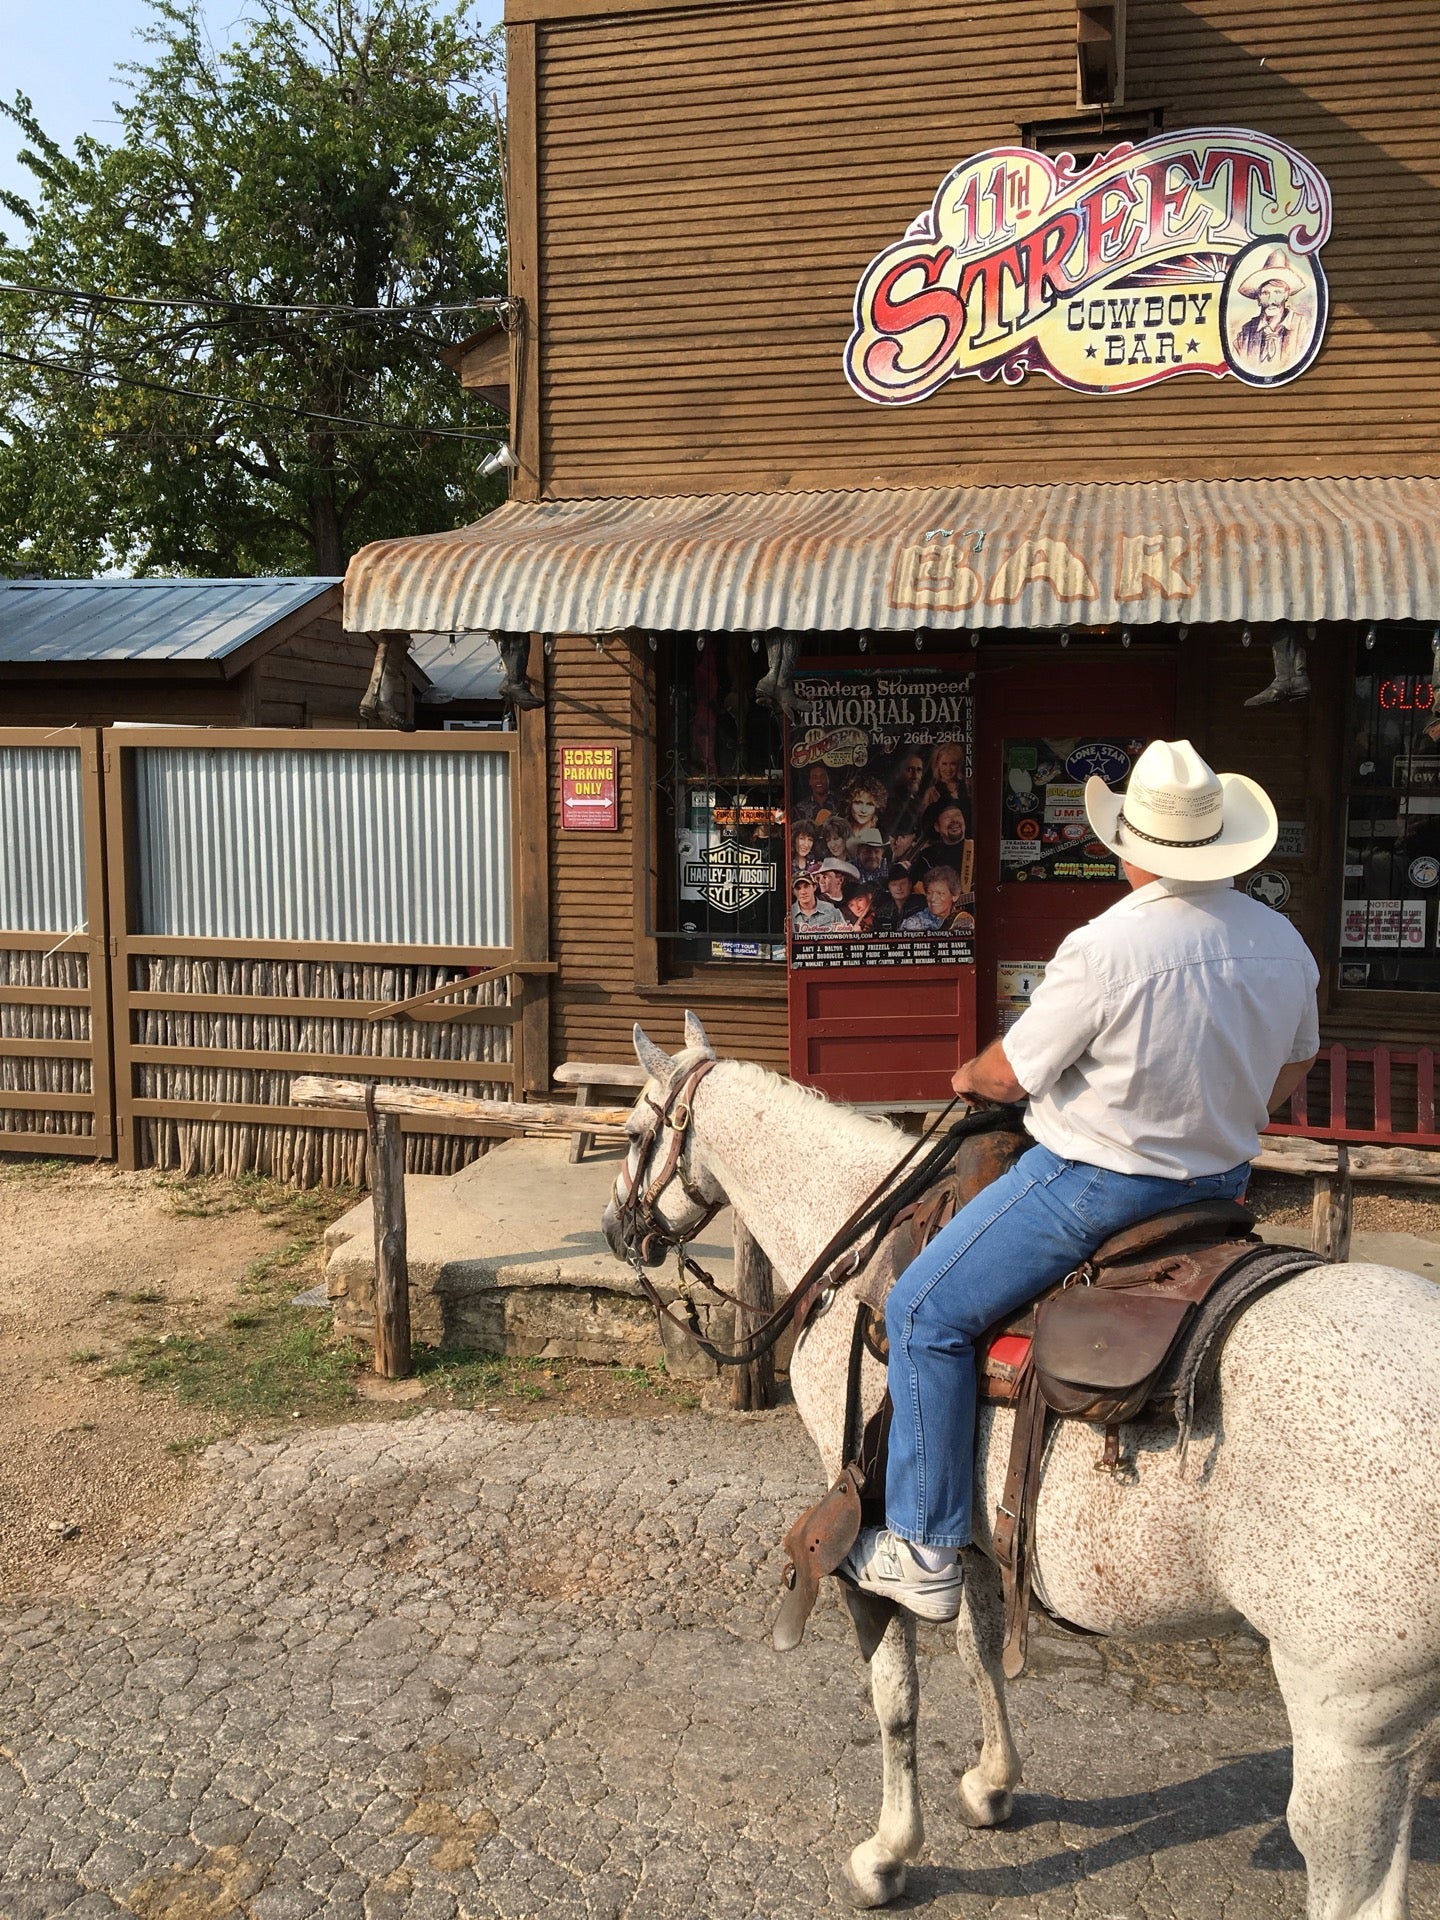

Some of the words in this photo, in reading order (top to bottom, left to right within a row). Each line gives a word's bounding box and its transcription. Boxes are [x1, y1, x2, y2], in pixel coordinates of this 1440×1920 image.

[864, 146, 1280, 391] STREET
[1067, 292, 1213, 332] COWBOY
[1104, 332, 1183, 367] BAR
[887, 533, 1196, 612] BAR
[876, 674, 970, 697] Stompeed
[919, 695, 965, 724] DAY
[872, 733, 900, 753] May
[904, 726, 966, 745] 26th-28th
[564, 750, 612, 765] HORSE
[1069, 747, 1097, 764] LONE
[1101, 746, 1126, 764] STAR
[564, 767, 613, 780] PARKING
[575, 782, 602, 795] ONLY
[709, 847, 751, 864] MOTOR
[690, 867, 770, 884] HARLEY-DAVIDSON
[709, 886, 752, 906] CYCLES
[1369, 901, 1400, 909] NOTICE
